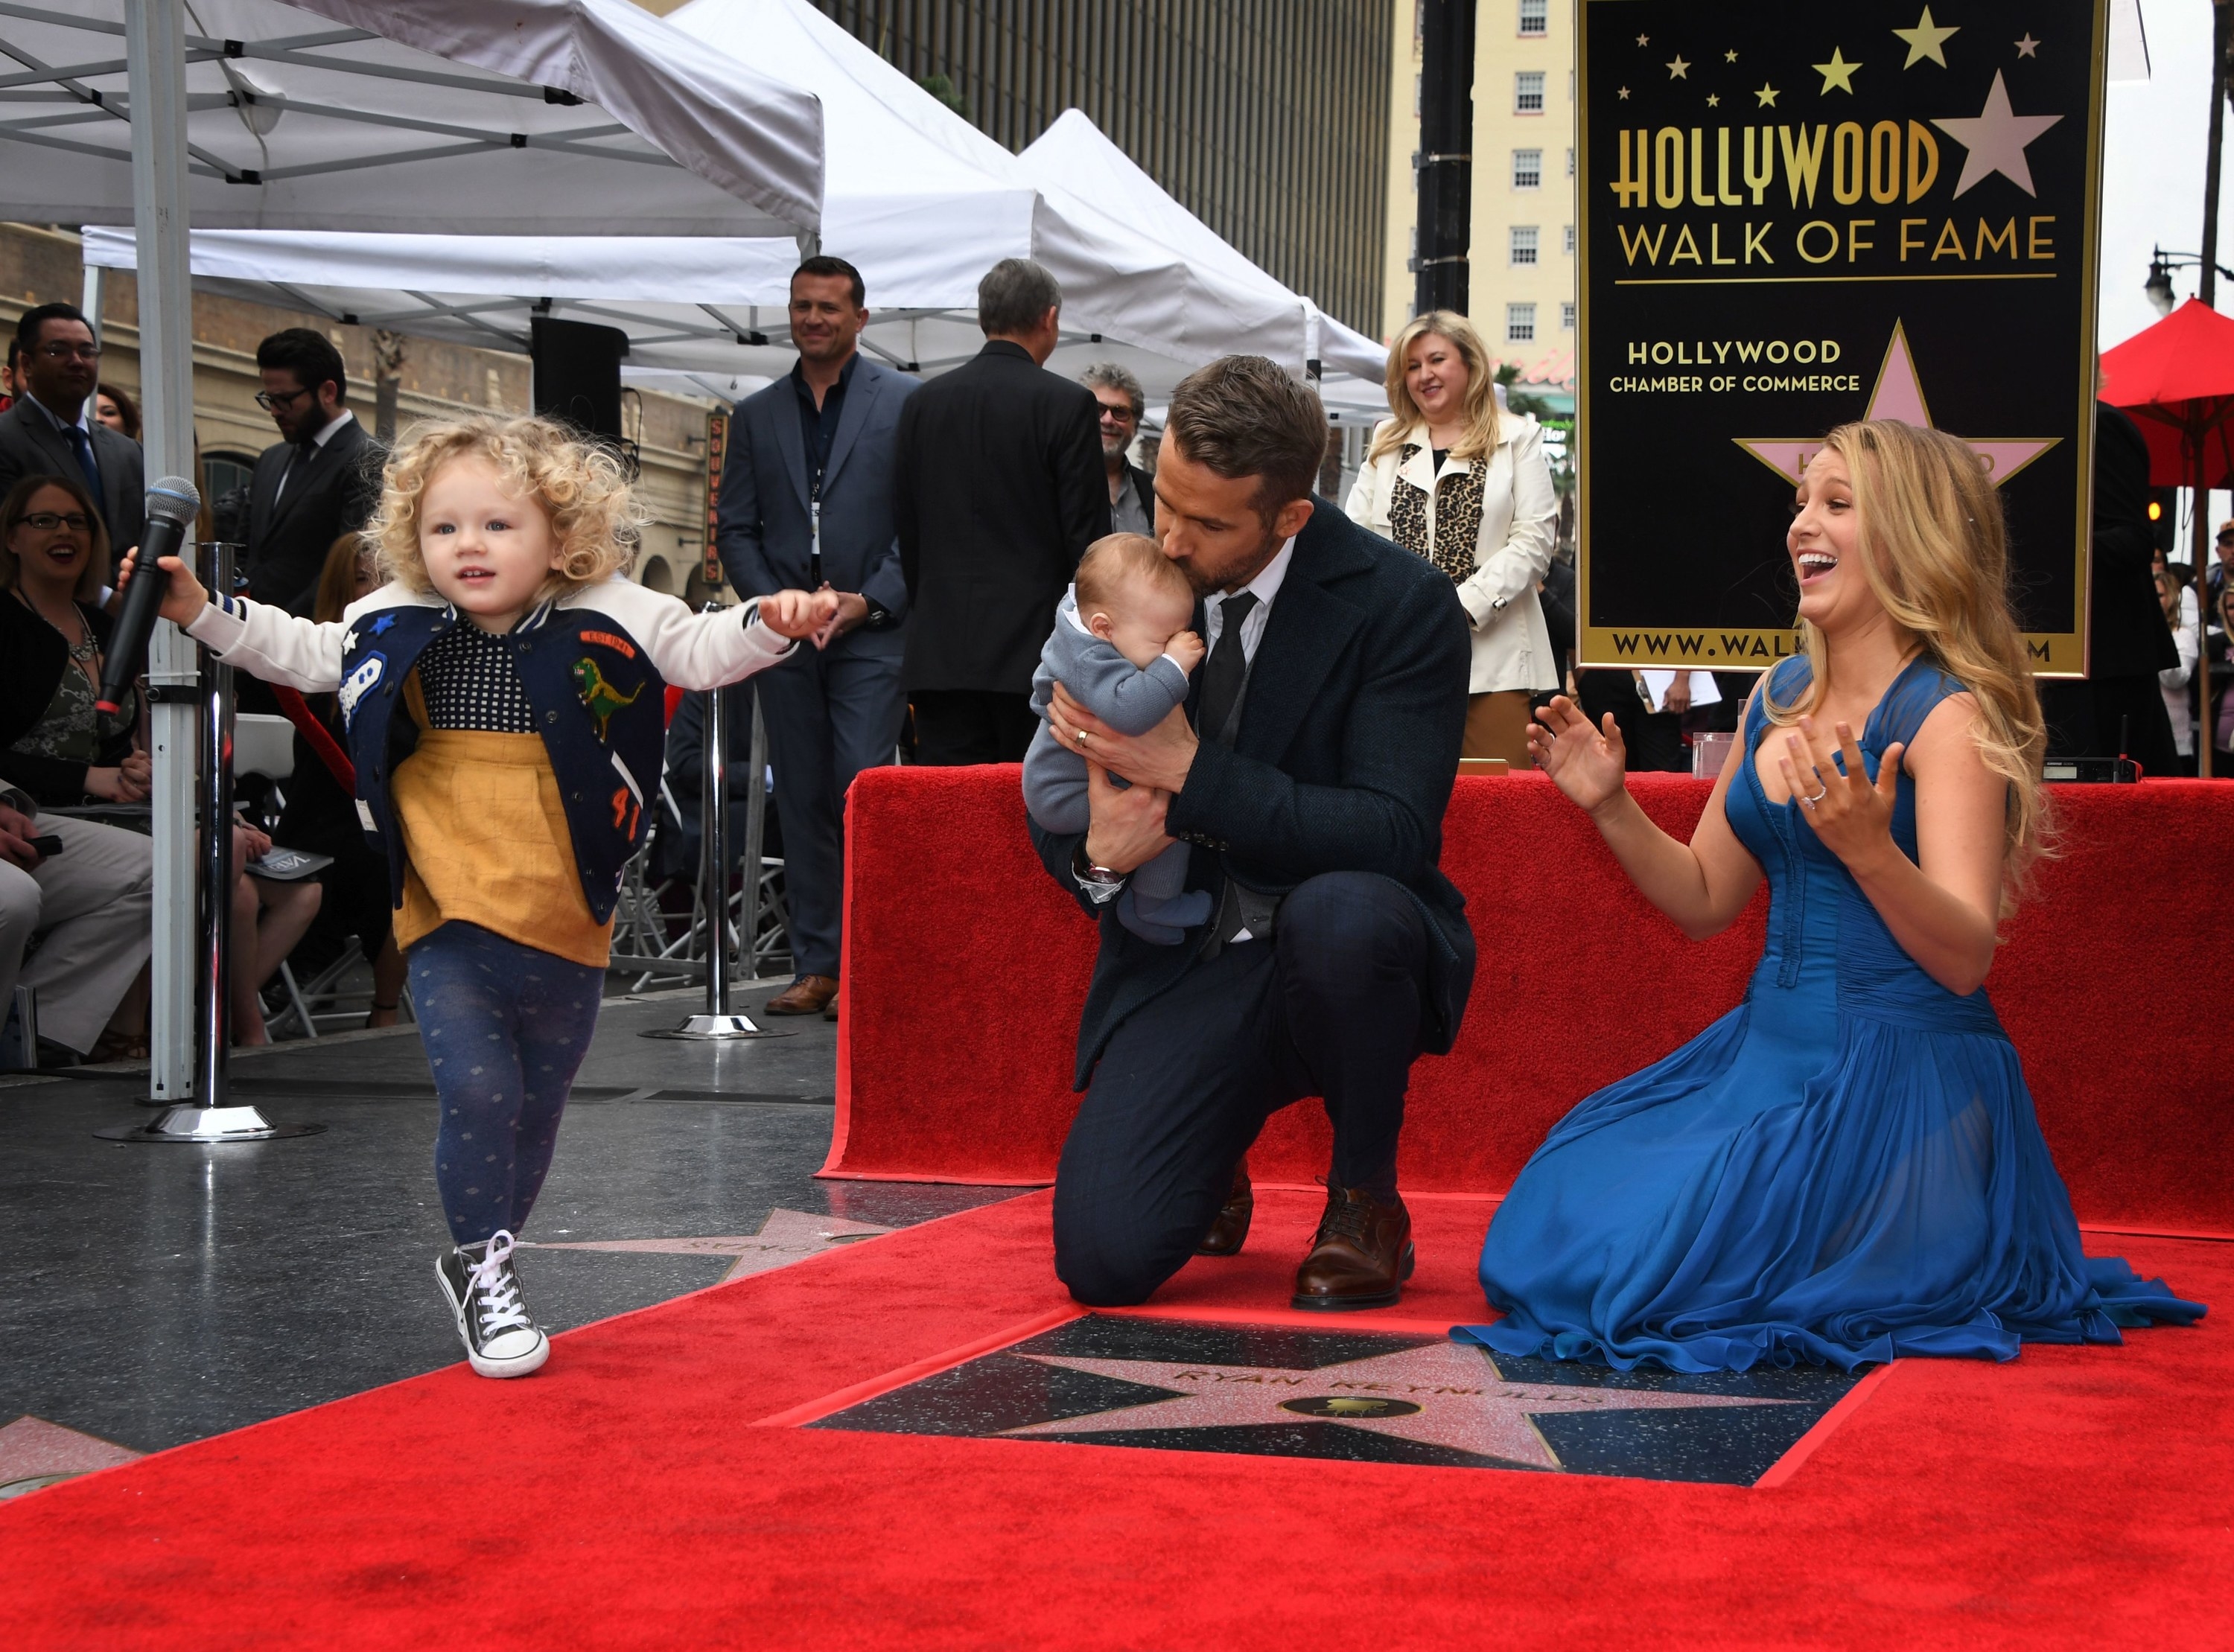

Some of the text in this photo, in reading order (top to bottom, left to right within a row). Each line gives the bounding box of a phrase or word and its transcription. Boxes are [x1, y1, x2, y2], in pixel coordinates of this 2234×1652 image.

[1609, 119, 1939, 209] HOLLYWOOD
[1617, 216, 2056, 267] WALK OF FAME
[1629, 340, 1841, 365] HOLLYWOOD
[1609, 375, 1860, 392] CHAMBER OF COMMERCE
[613, 786, 640, 842] 41
[1173, 1370, 1308, 1385] RYAN
